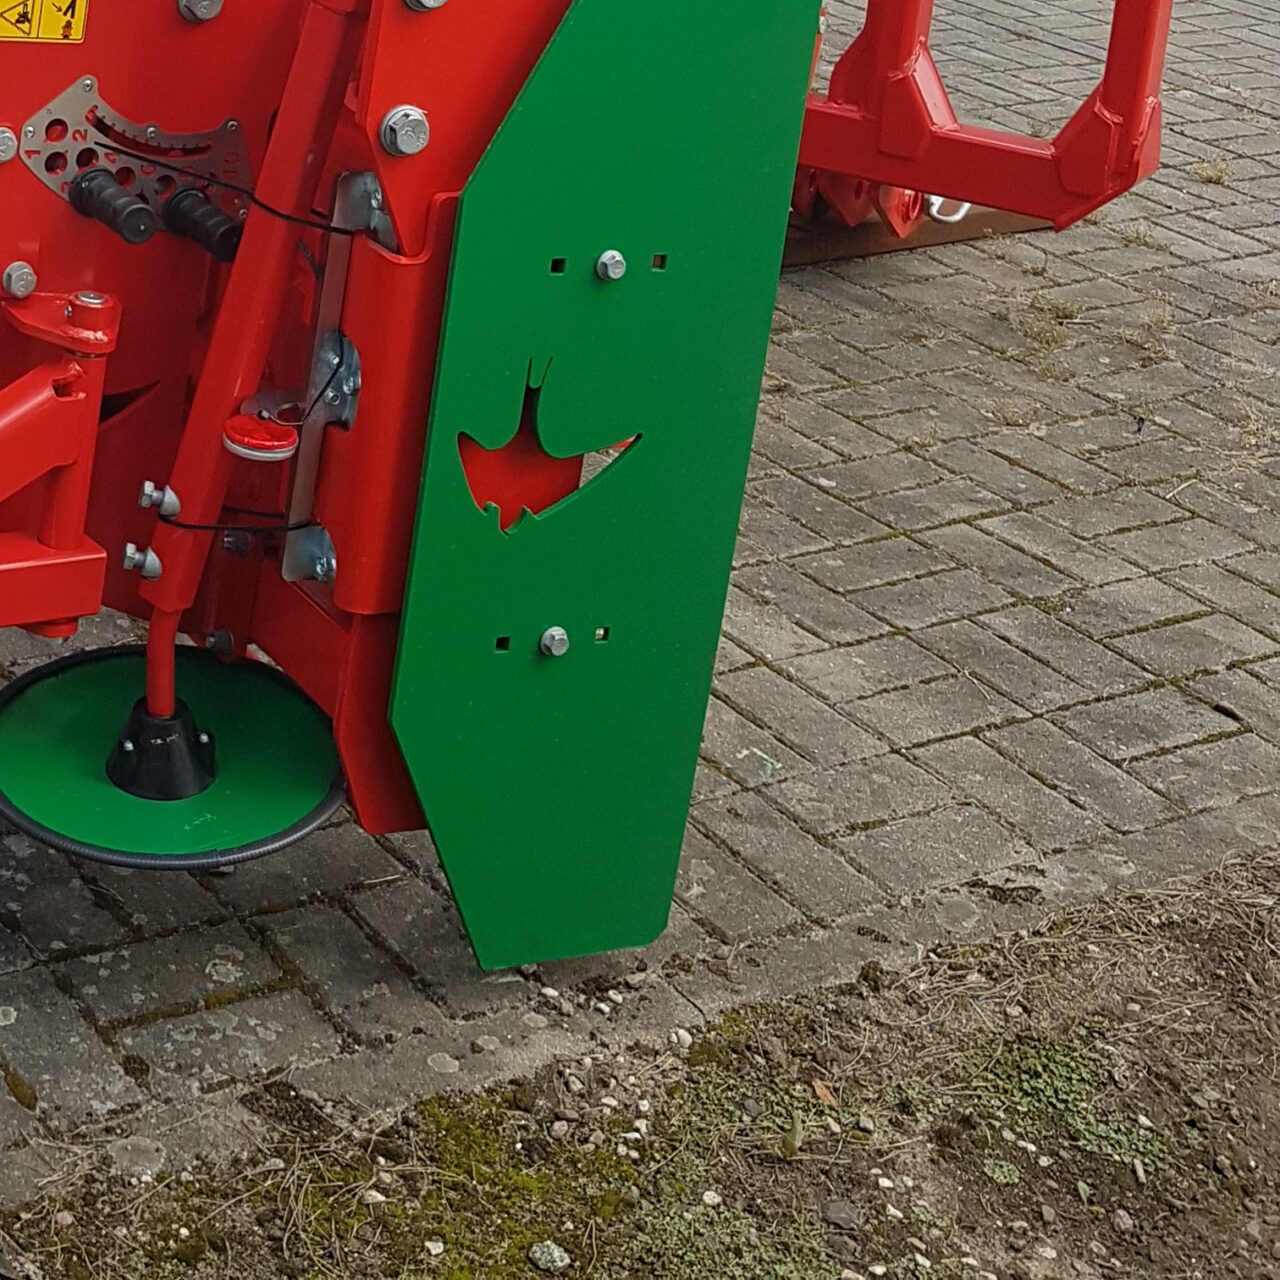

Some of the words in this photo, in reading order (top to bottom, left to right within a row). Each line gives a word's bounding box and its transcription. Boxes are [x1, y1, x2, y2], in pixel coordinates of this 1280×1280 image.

[72, 128, 88, 143] 2
[24, 149, 41, 159] 1
[104, 151, 118, 164] 4
